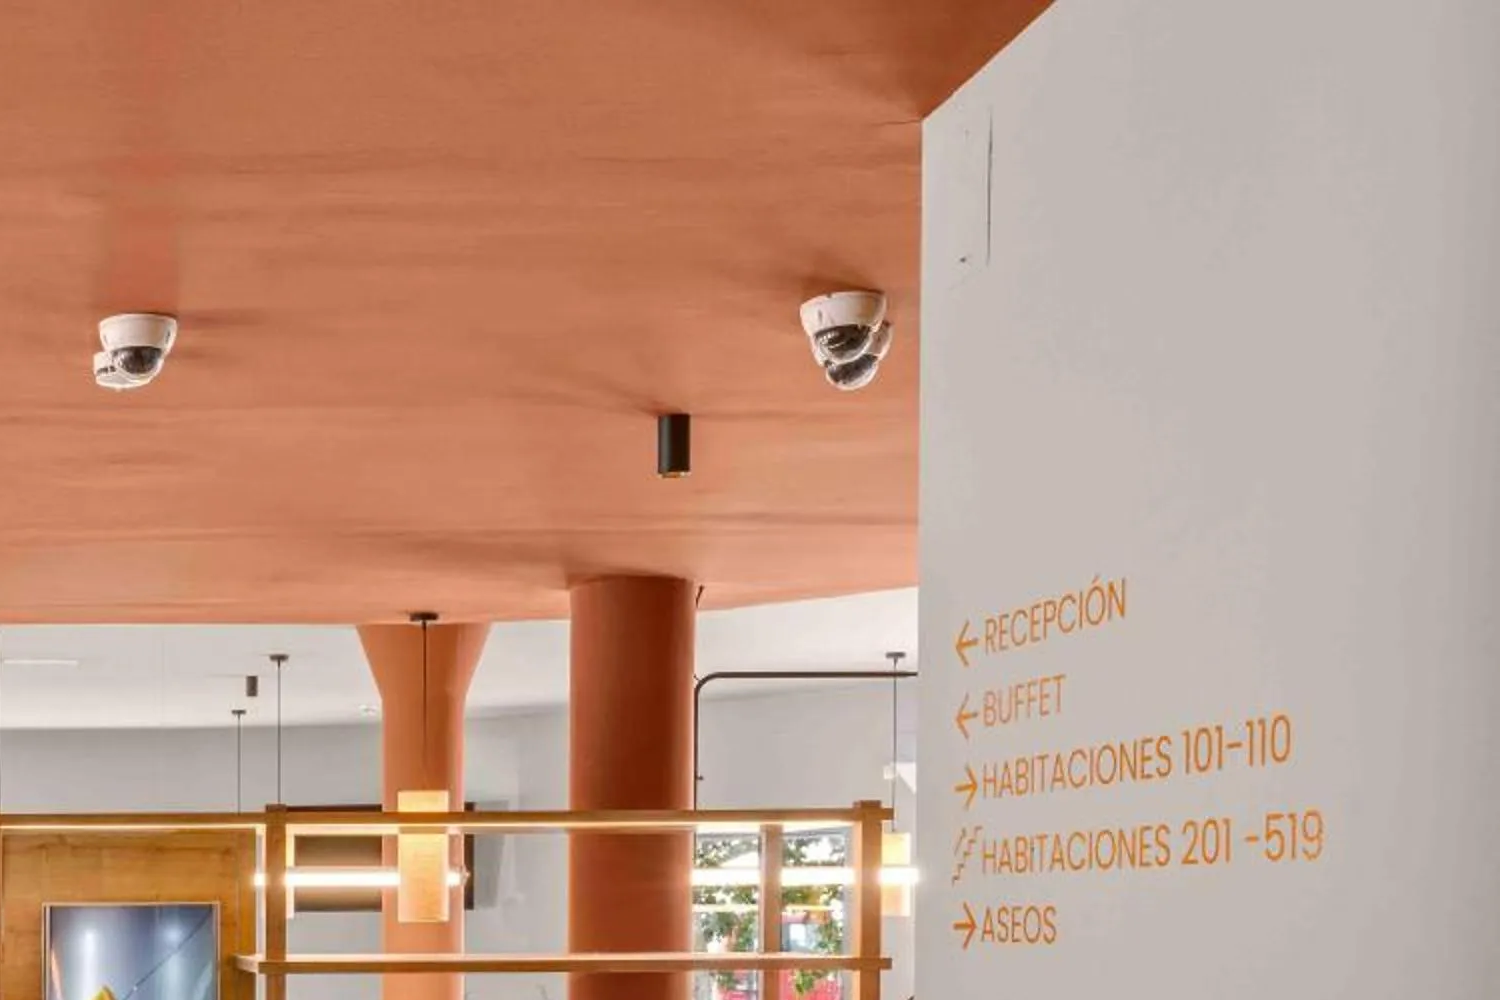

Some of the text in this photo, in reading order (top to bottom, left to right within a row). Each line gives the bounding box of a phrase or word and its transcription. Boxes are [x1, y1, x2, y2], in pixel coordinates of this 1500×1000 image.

[984, 575, 1128, 655] RECEPCIÓN
[983, 673, 1067, 727] BUFFET
[982, 712, 1292, 799] HABITACIONES 101-110
[981, 823, 1172, 875] HABITACIONES
[1180, 816, 1232, 866] 201
[980, 904, 1059, 946] ASEOS
